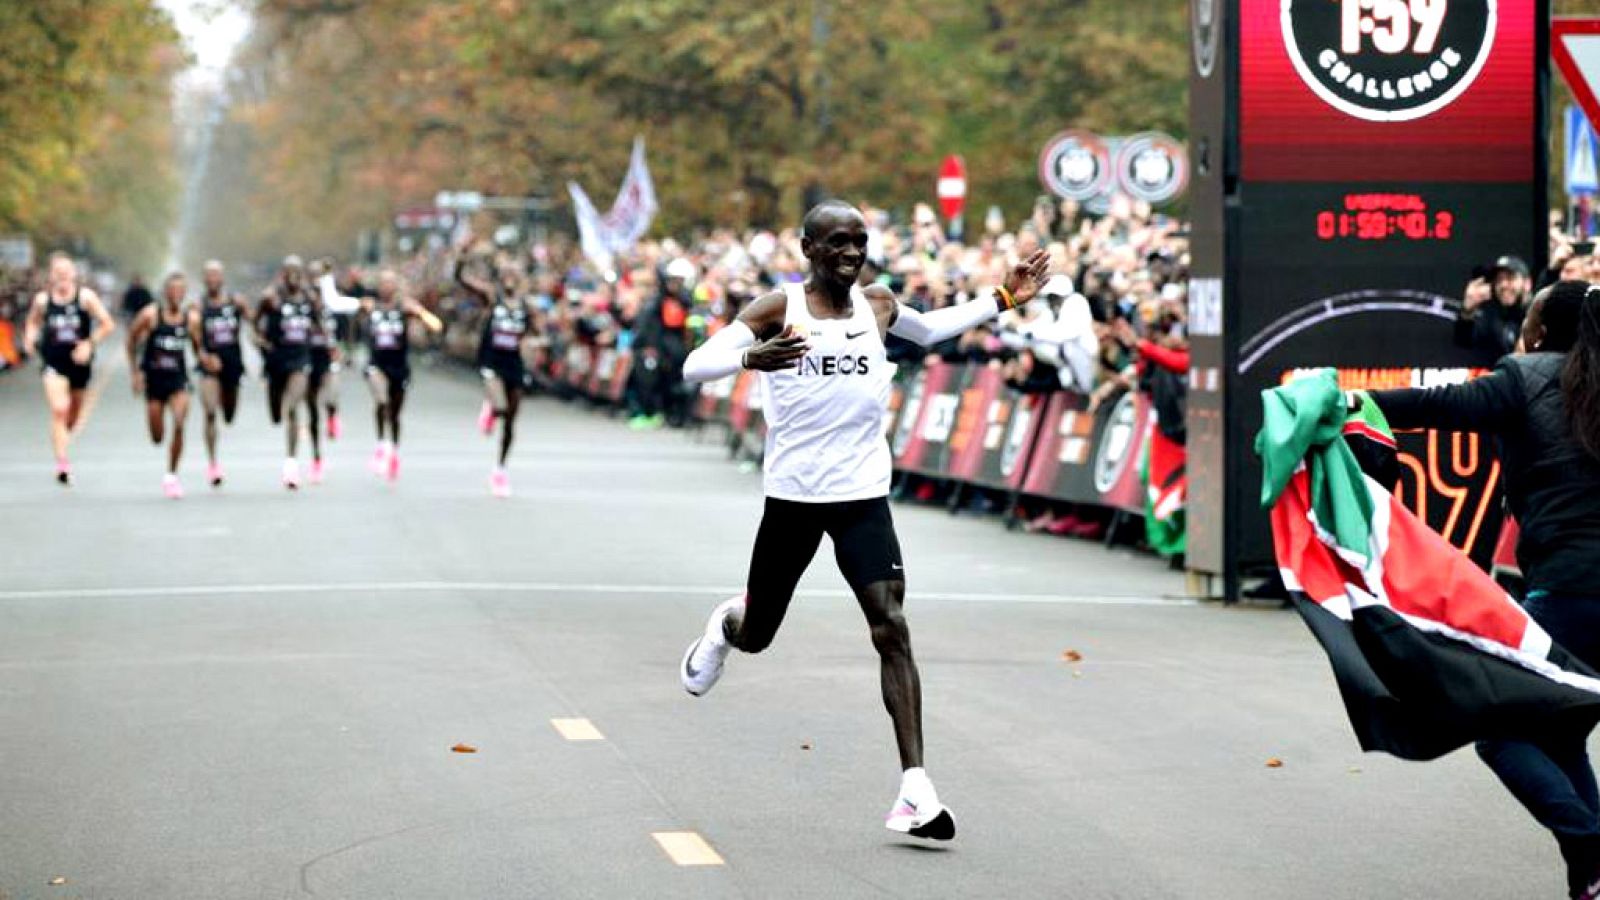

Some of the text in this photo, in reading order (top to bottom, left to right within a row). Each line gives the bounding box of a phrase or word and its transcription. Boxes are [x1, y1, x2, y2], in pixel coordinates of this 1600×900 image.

[1341, 0, 1447, 53] 1:59
[1319, 47, 1461, 99] CHALLENGE
[797, 355, 869, 375] INEOS
